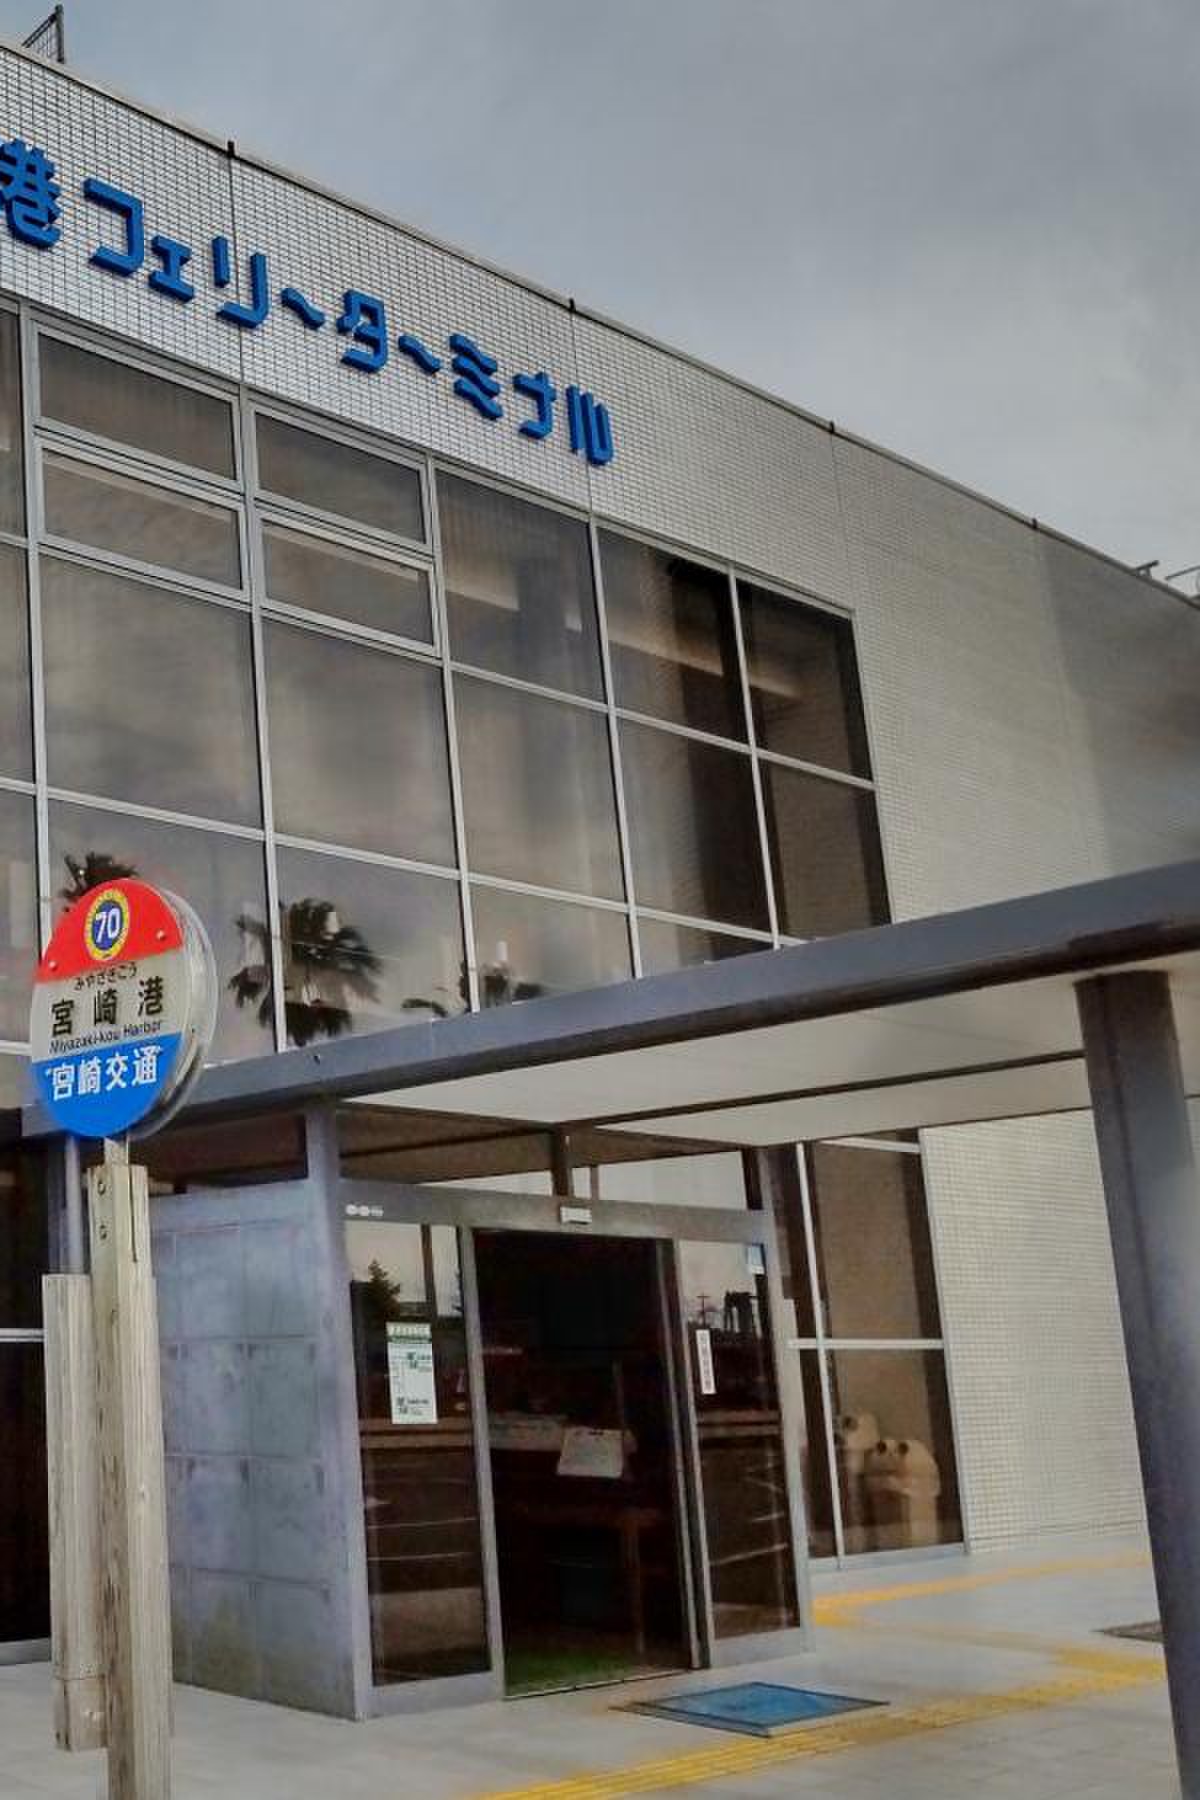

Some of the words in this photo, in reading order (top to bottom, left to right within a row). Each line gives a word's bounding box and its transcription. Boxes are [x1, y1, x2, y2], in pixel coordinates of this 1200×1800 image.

[95, 908, 121, 944] 70
[51, 976, 163, 1037] 宮崎港
[46, 1045, 162, 1101] 宮崎交通
